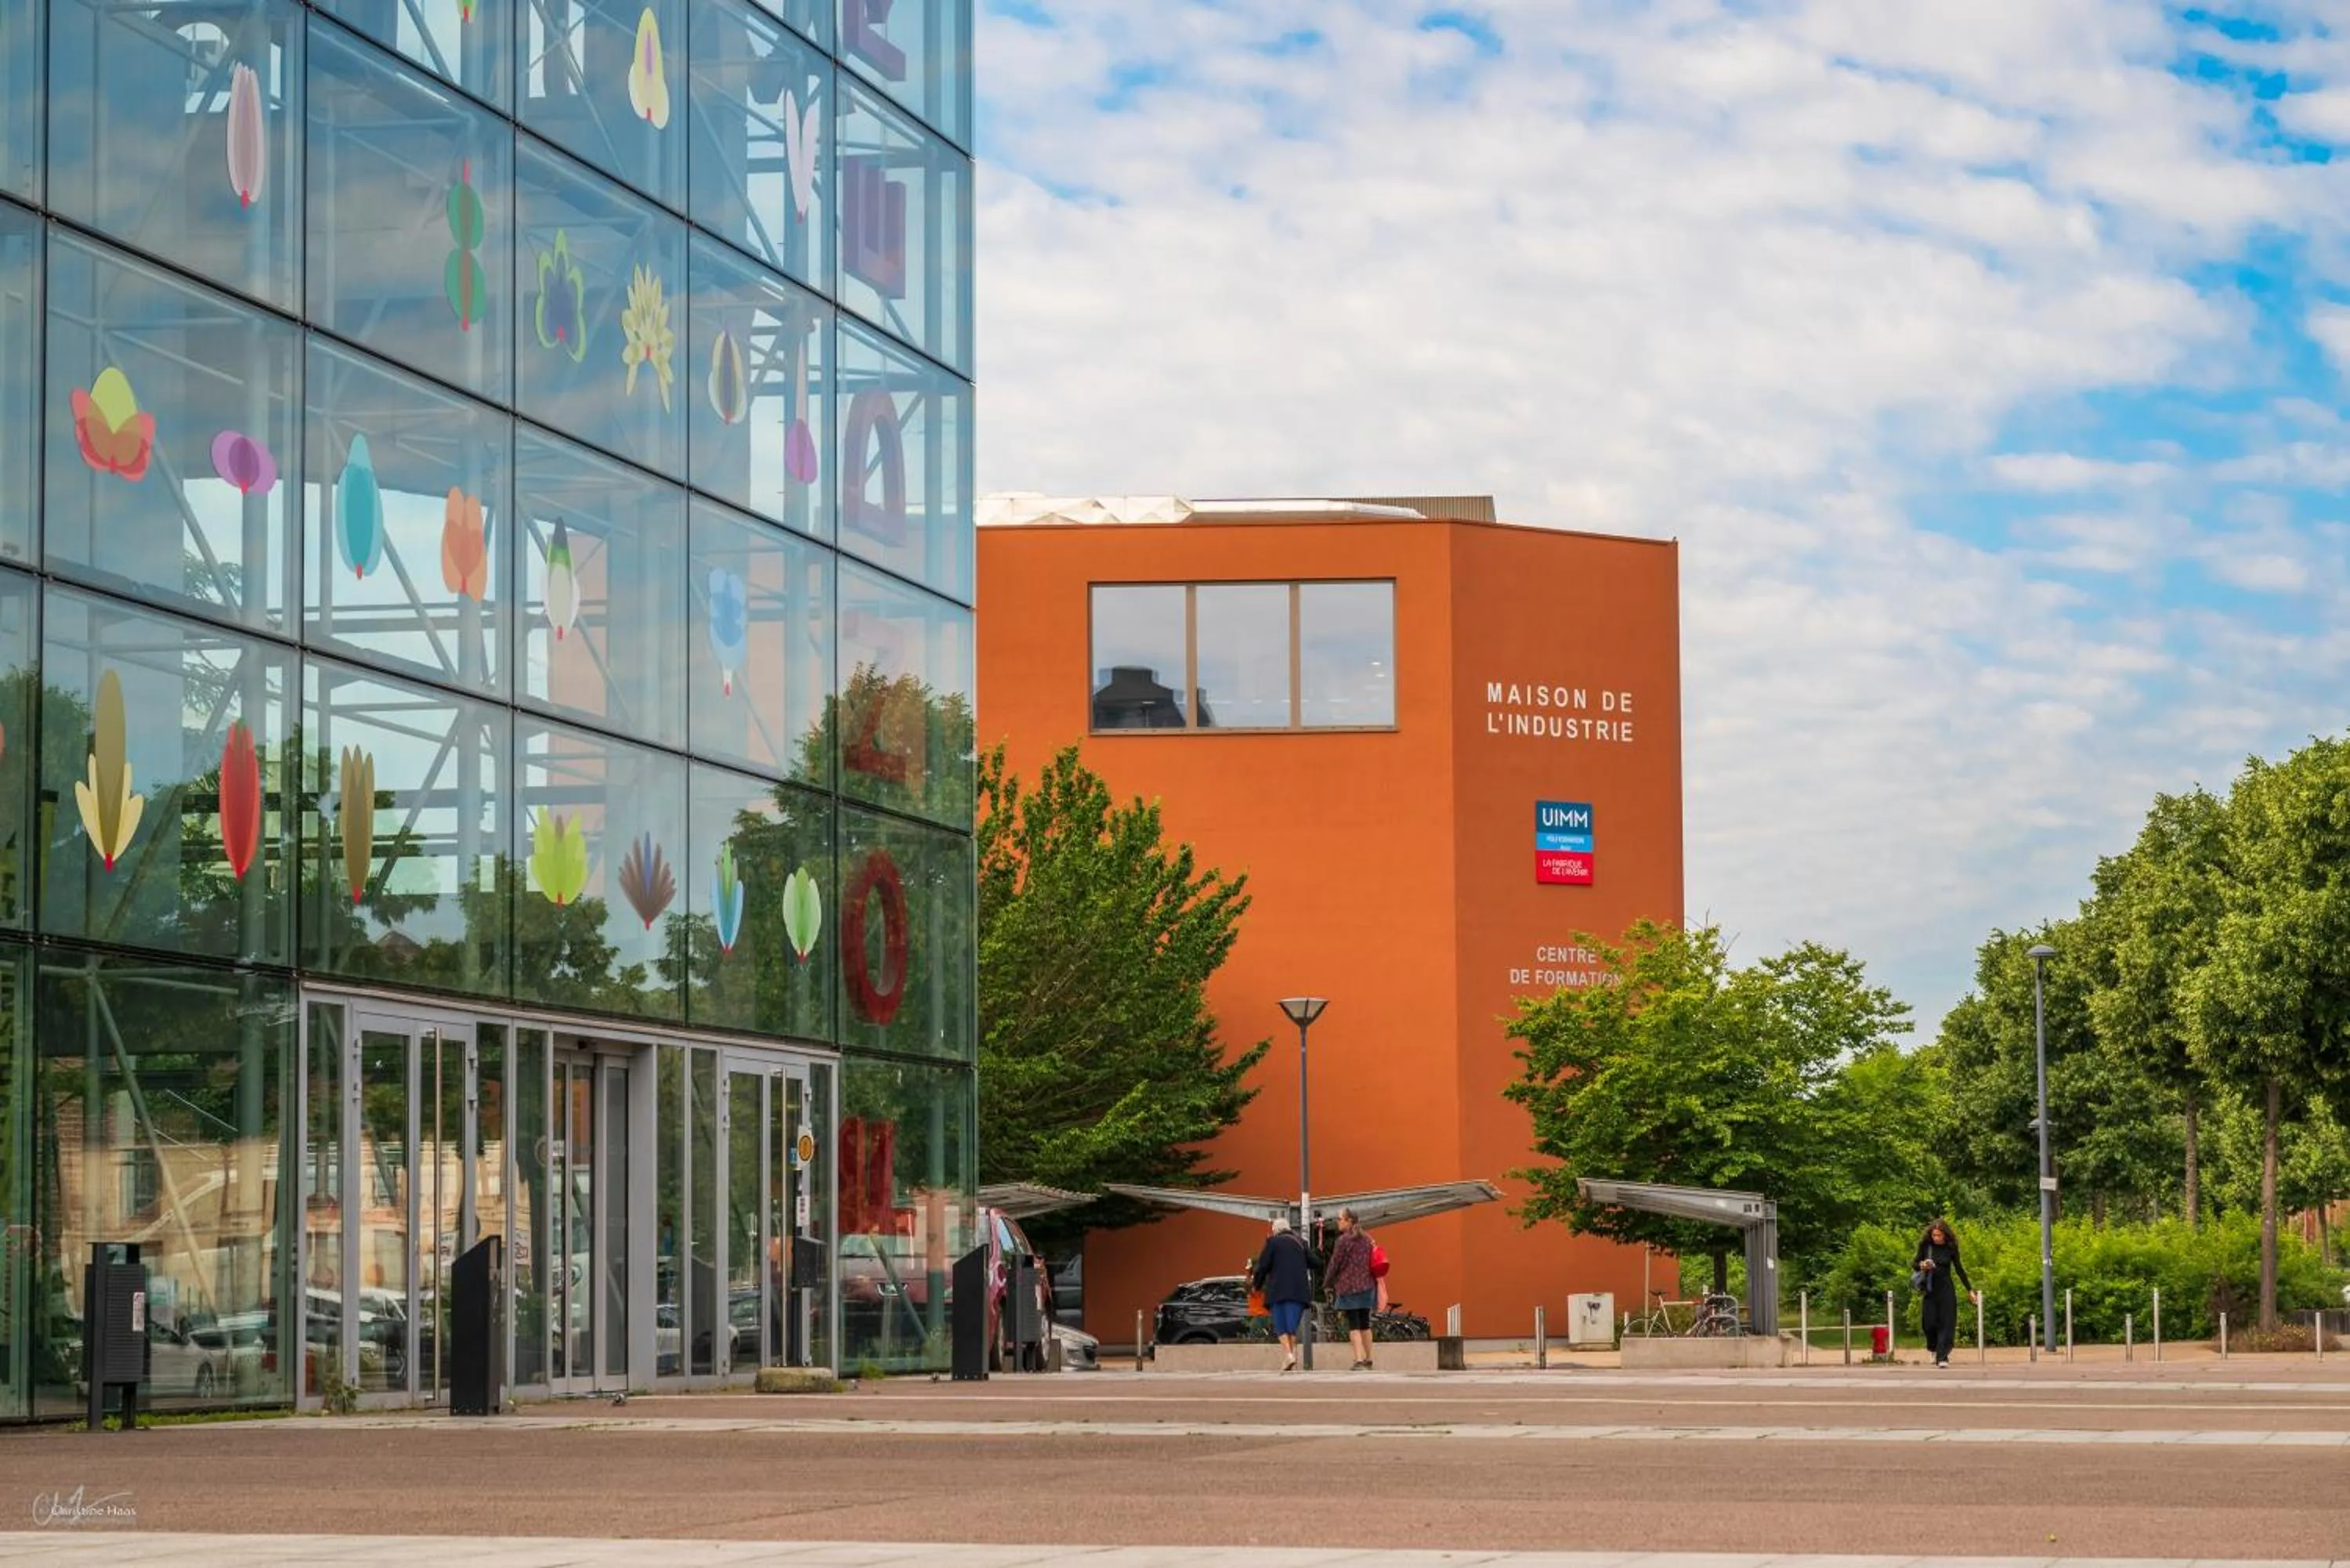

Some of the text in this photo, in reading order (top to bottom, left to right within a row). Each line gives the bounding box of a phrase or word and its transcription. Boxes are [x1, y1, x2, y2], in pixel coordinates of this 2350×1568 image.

[1488, 681, 1632, 714] MAISON DE
[1488, 712, 1633, 742] L'INDUSTRIE
[1542, 807, 1588, 828] UIMM
[1536, 946, 1596, 964] CENTRE
[1509, 969, 1530, 984] DE
